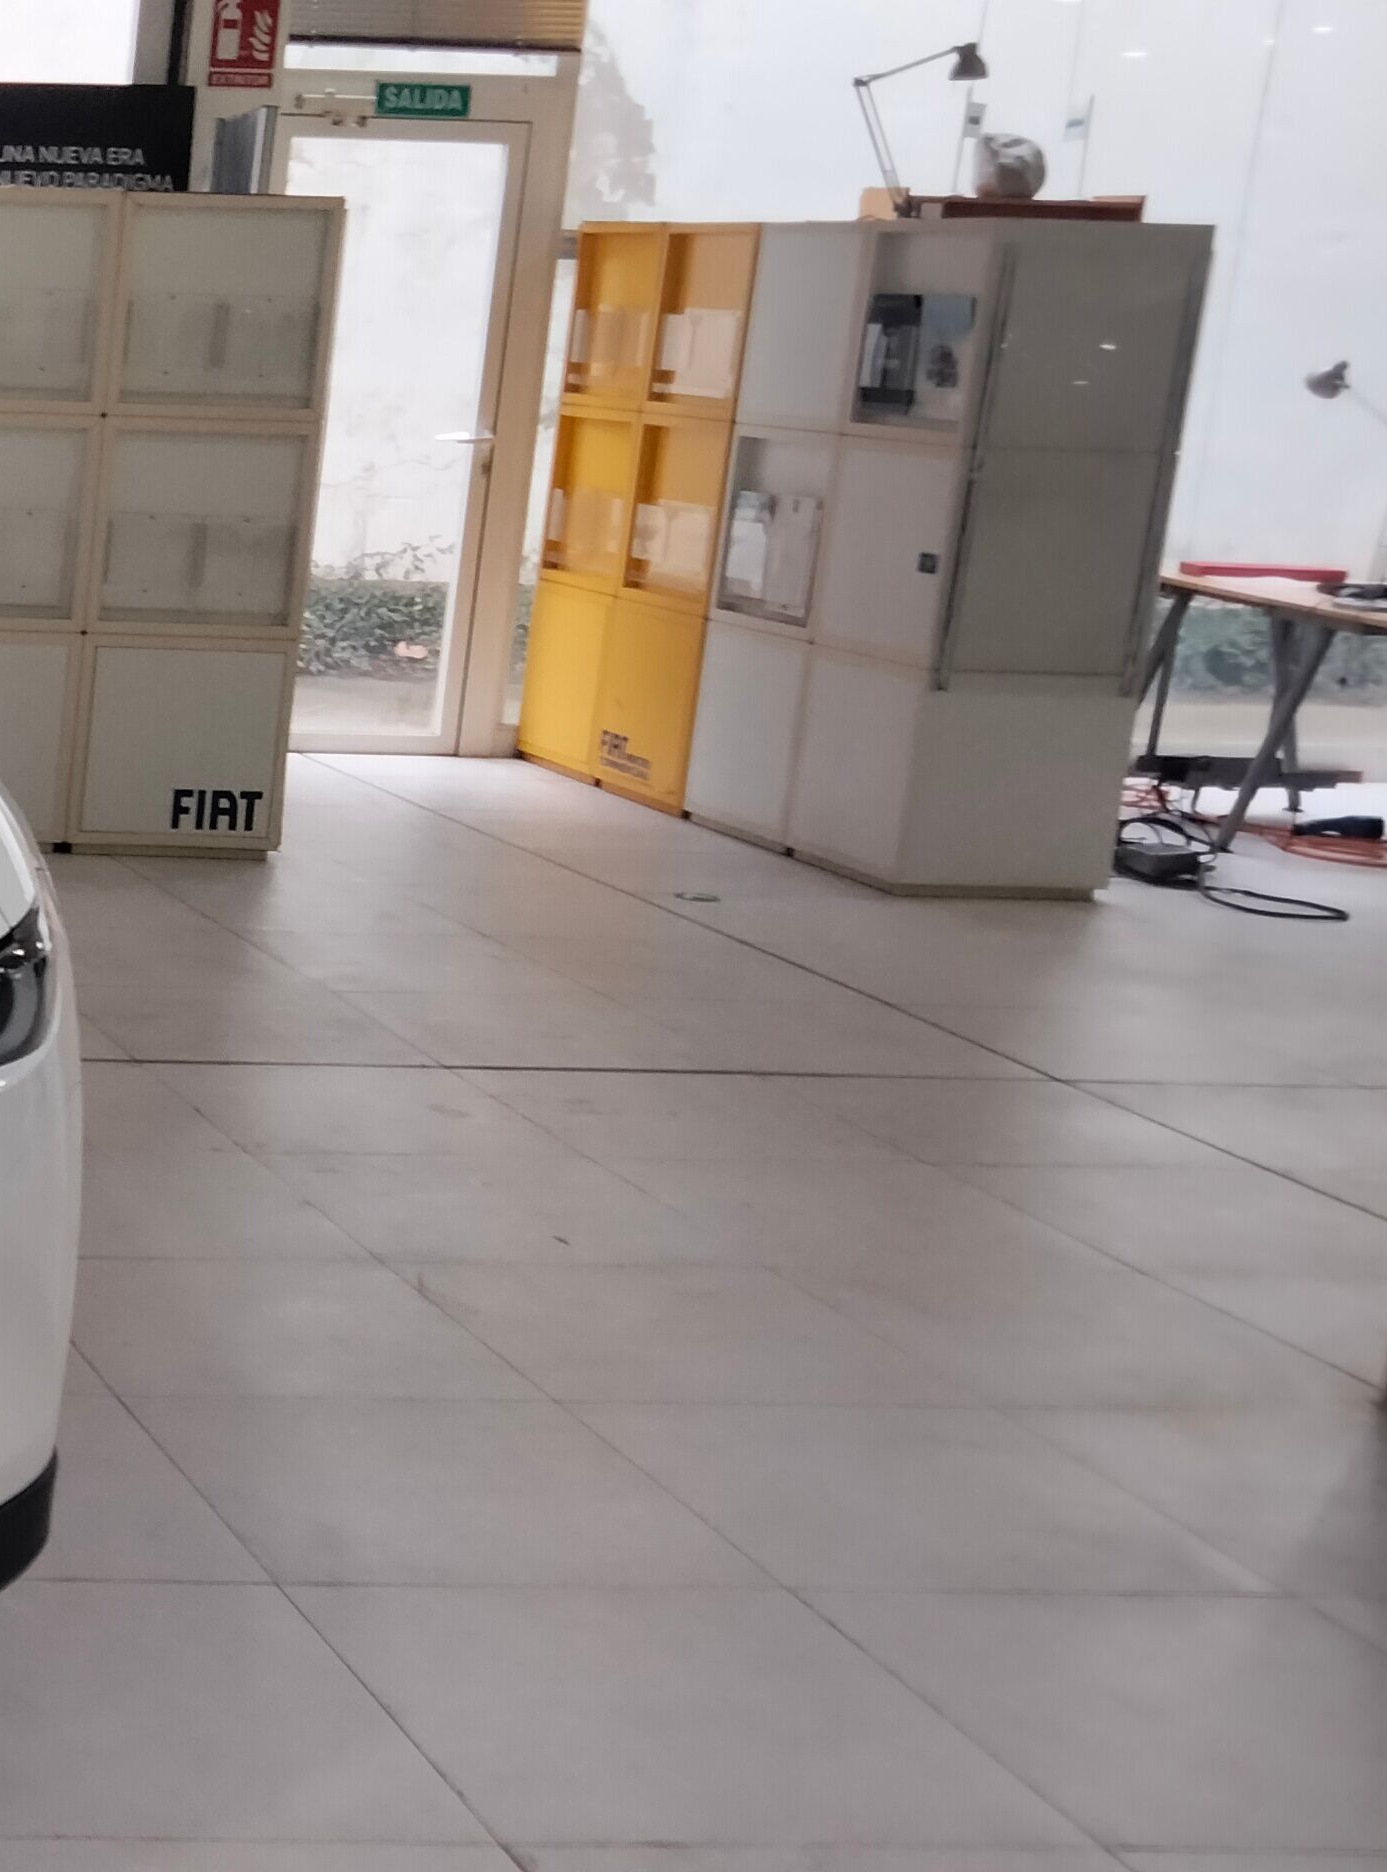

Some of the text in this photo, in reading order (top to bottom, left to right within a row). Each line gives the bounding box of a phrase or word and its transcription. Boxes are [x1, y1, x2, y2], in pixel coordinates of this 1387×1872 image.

[384, 86, 462, 111] SALIDA
[37, 145, 104, 166] NUEVA
[106, 147, 146, 167] ERA
[170, 788, 264, 831] FIAT
